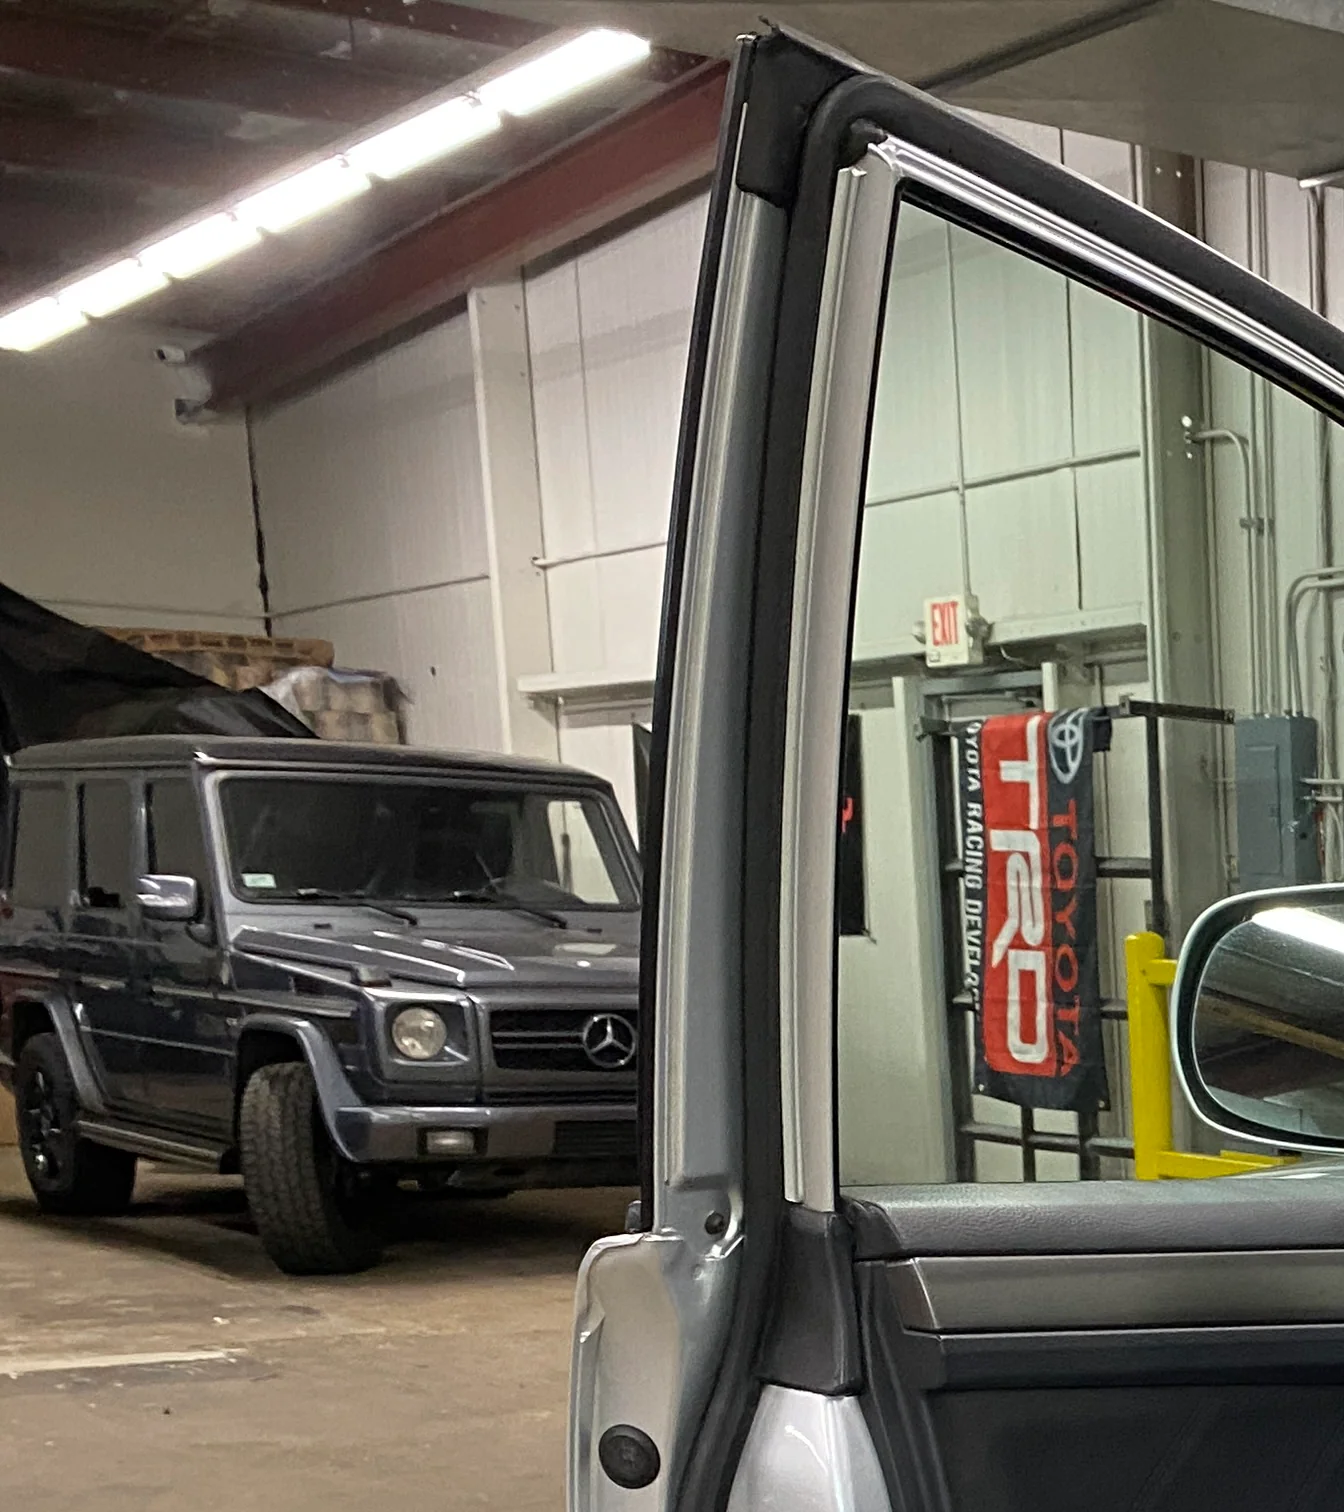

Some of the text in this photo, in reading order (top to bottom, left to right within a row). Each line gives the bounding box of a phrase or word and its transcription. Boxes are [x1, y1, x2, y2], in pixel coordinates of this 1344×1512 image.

[931, 601, 959, 646] EXIT
[965, 722, 982, 792] OYOTA
[965, 802, 984, 890] RACING
[991, 714, 1048, 1064] TRD
[1049, 798, 1082, 1076] TOYOTA
